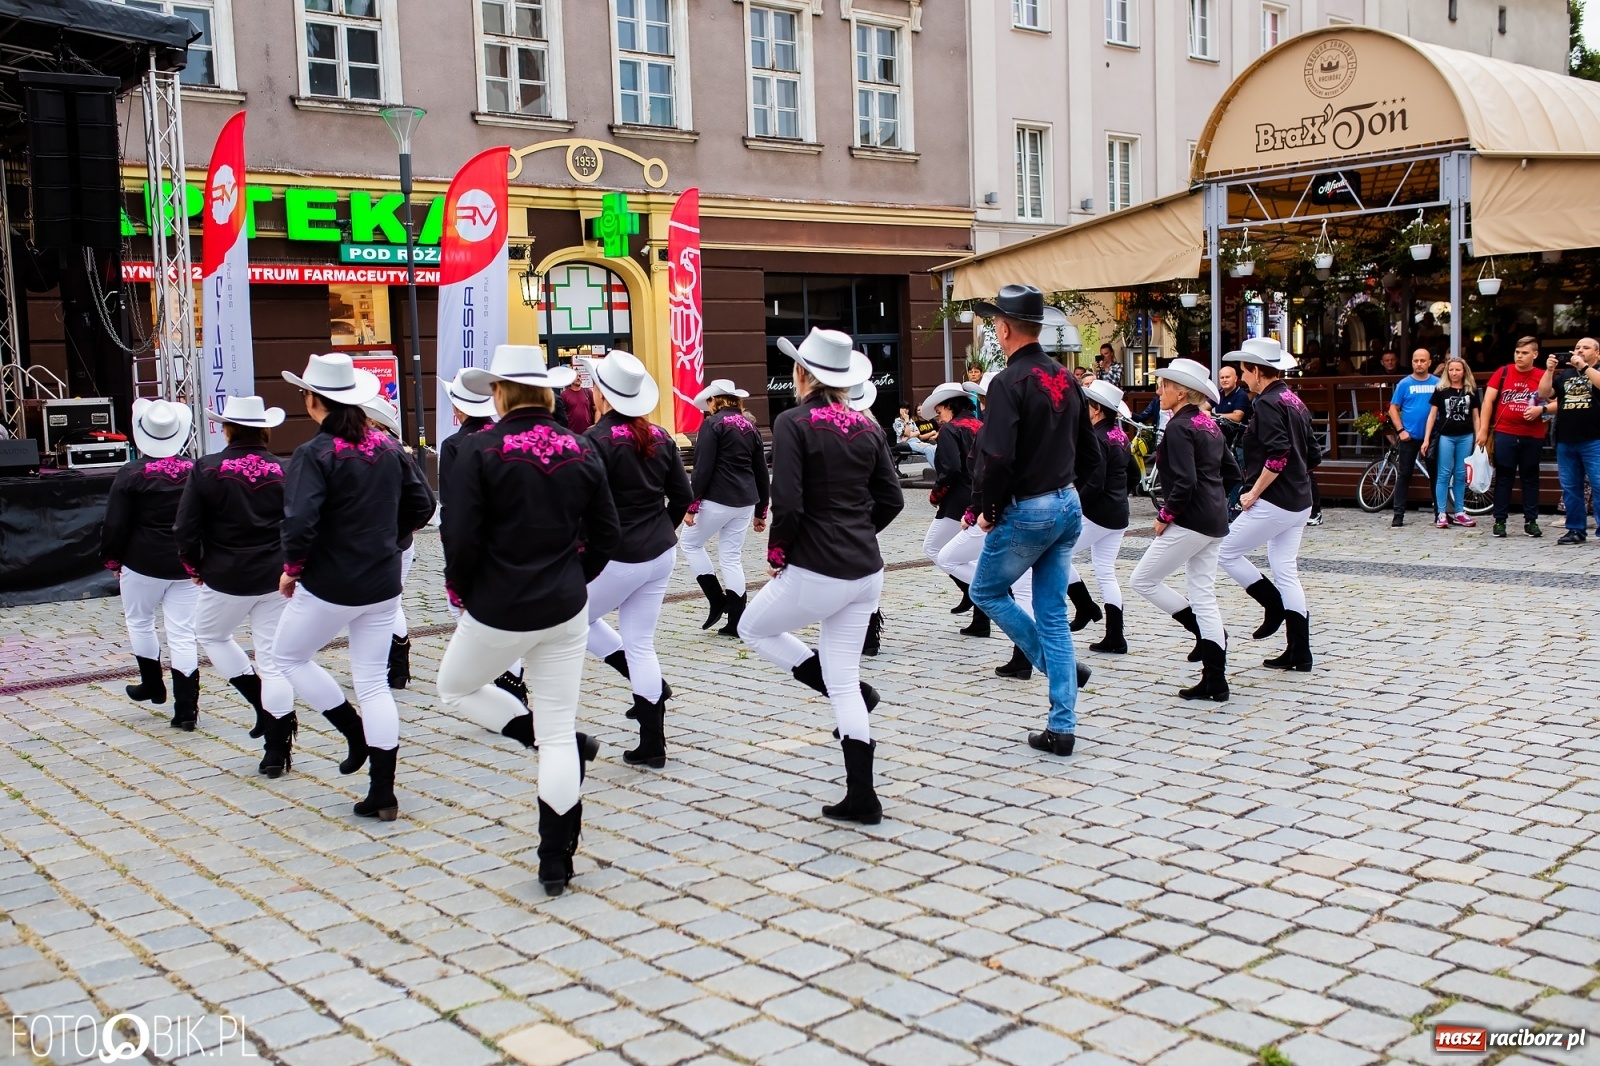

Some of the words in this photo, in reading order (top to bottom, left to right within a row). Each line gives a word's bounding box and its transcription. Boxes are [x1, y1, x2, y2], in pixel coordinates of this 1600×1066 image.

[575, 156, 596, 167] 1953
[350, 247, 391, 260] POD
[483, 276, 489, 292] FM
